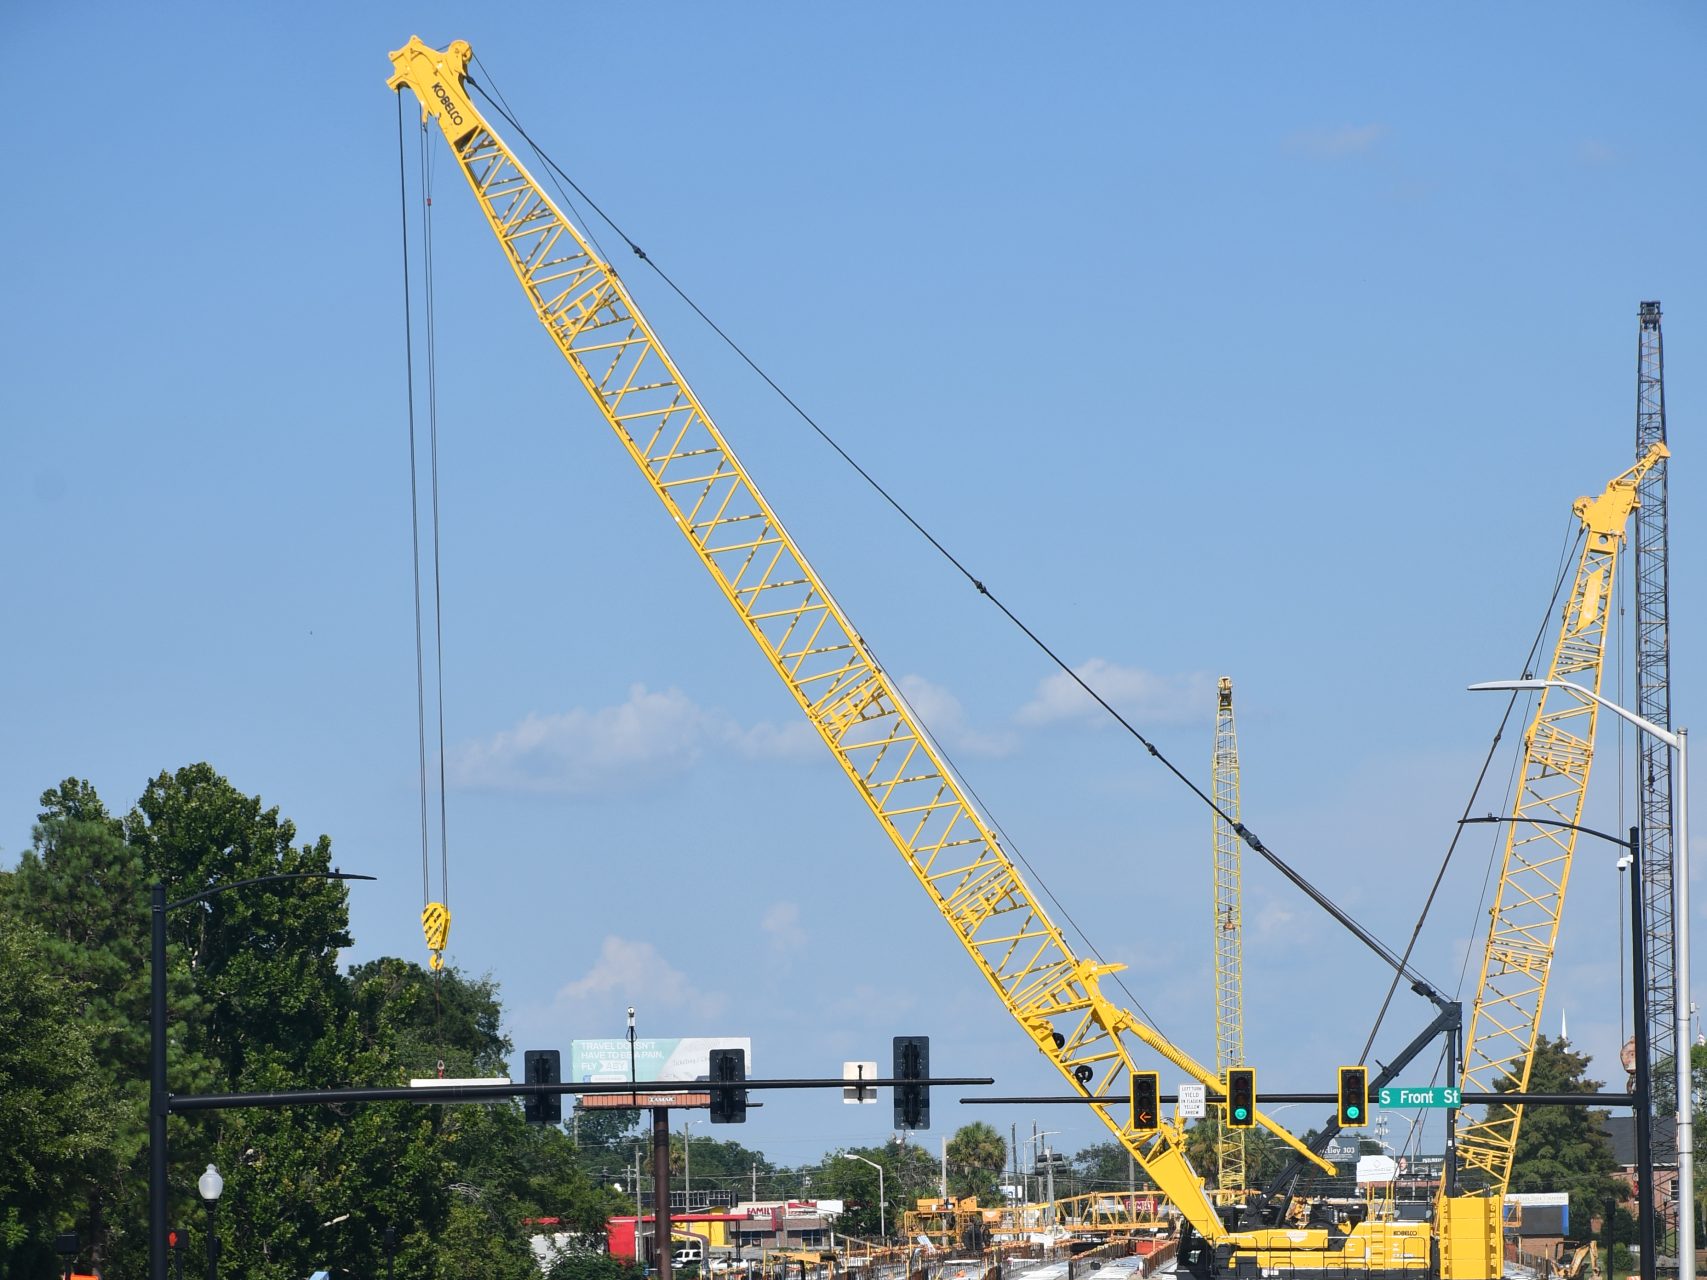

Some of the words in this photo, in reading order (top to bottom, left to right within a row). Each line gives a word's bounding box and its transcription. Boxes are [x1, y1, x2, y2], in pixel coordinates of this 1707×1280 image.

[431, 82, 463, 126] KOBELCO
[582, 1042, 616, 1050] TRAVEL
[582, 1051, 606, 1060] HAVE
[581, 1062, 597, 1071] FLY
[1381, 1090, 1391, 1104] S
[1400, 1090, 1434, 1104] Front
[1444, 1089, 1459, 1104] St
